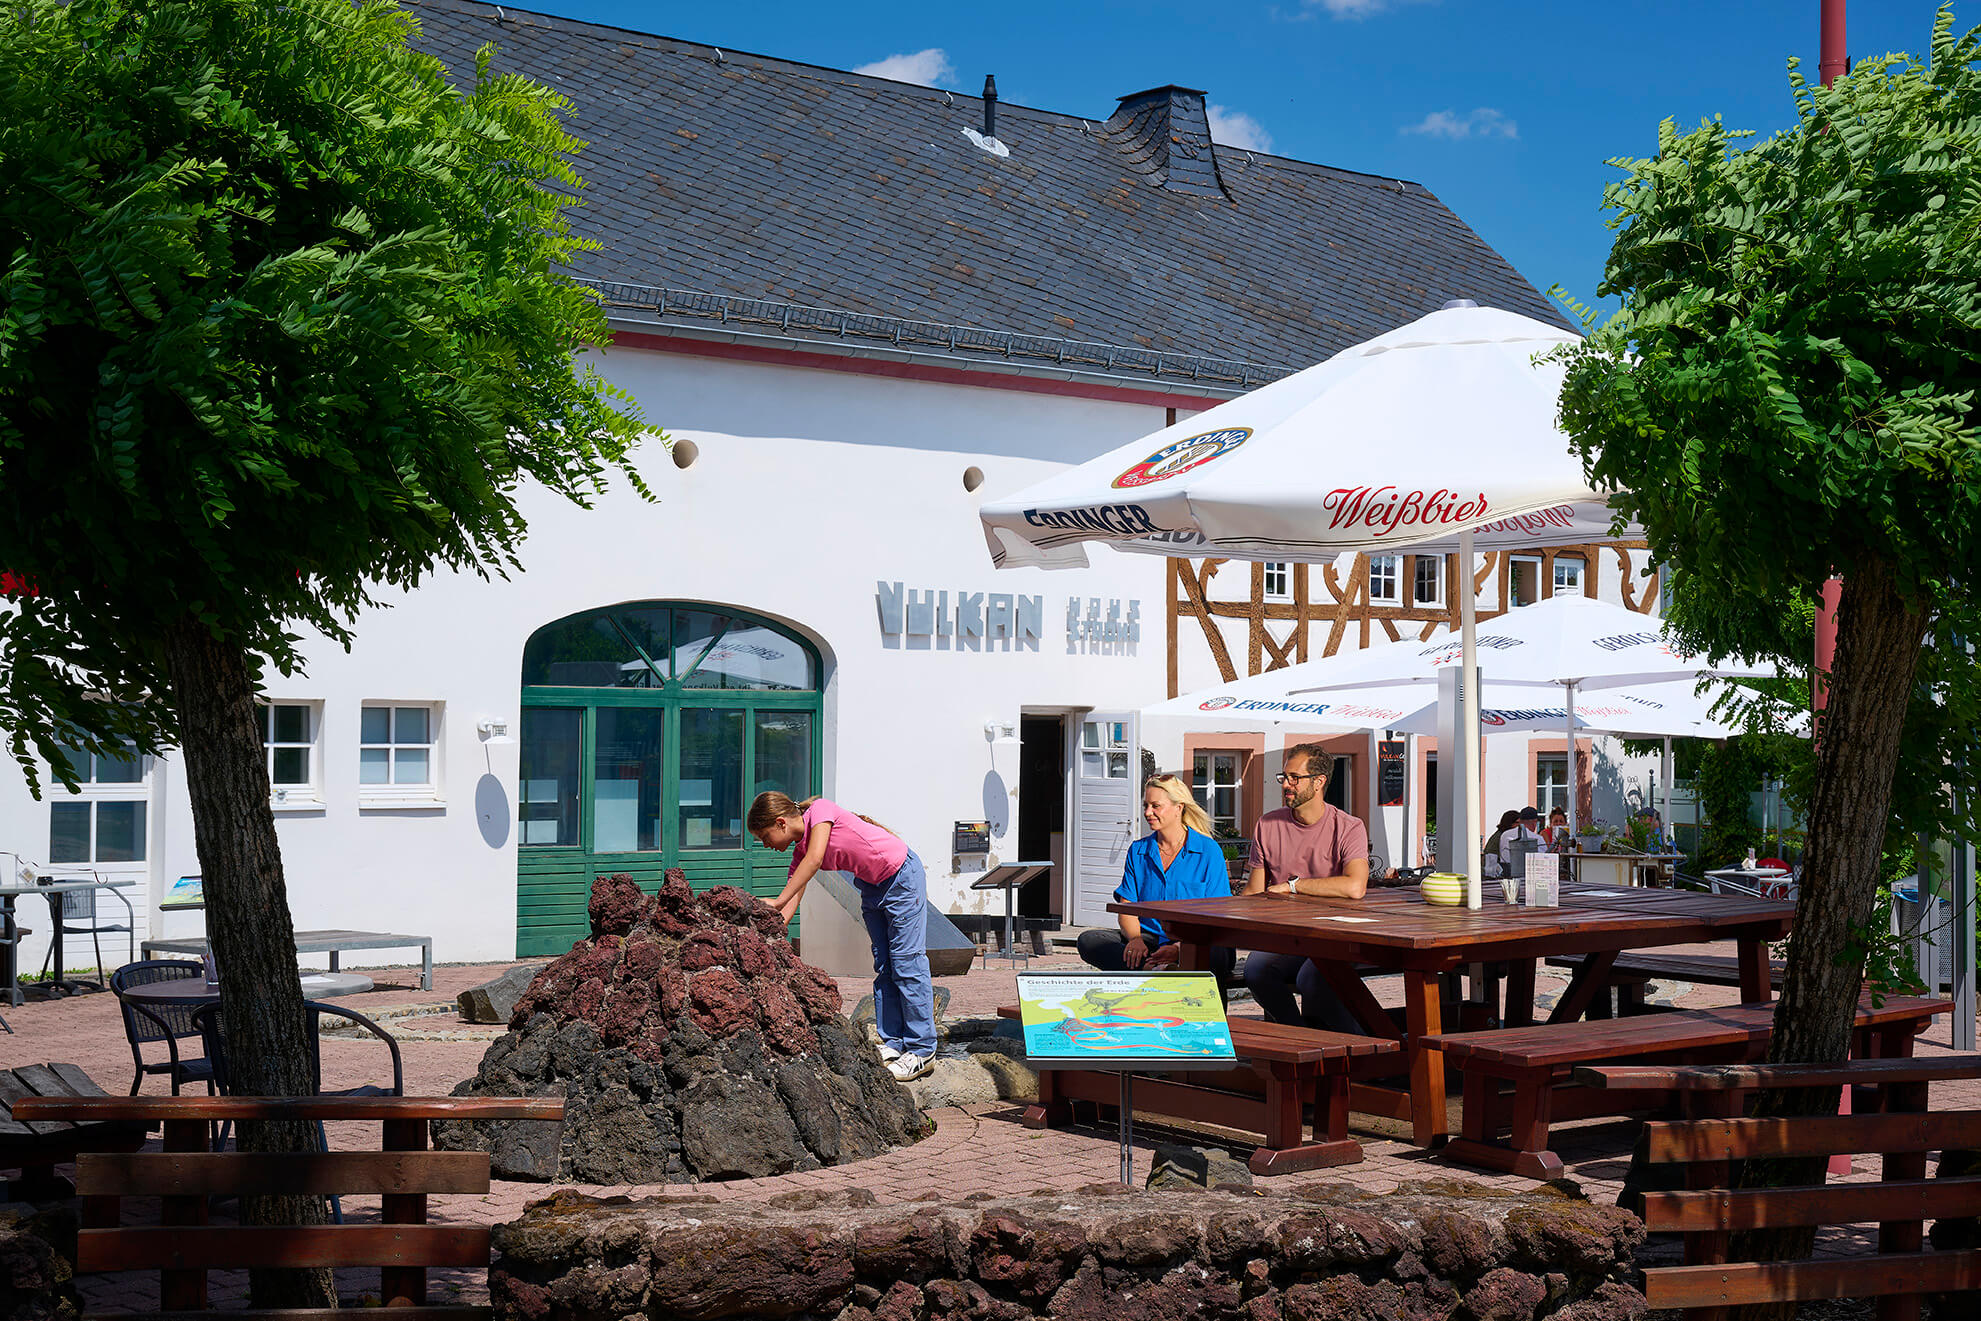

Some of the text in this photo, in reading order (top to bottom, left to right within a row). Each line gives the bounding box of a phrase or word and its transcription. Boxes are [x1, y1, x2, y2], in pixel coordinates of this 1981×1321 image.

[1323, 485, 1492, 537] Weißbier
[874, 580, 1043, 640] VULKAN
[1233, 699, 1331, 716] ERDINGER
[1026, 978, 1131, 986] Geschichte der Erde
